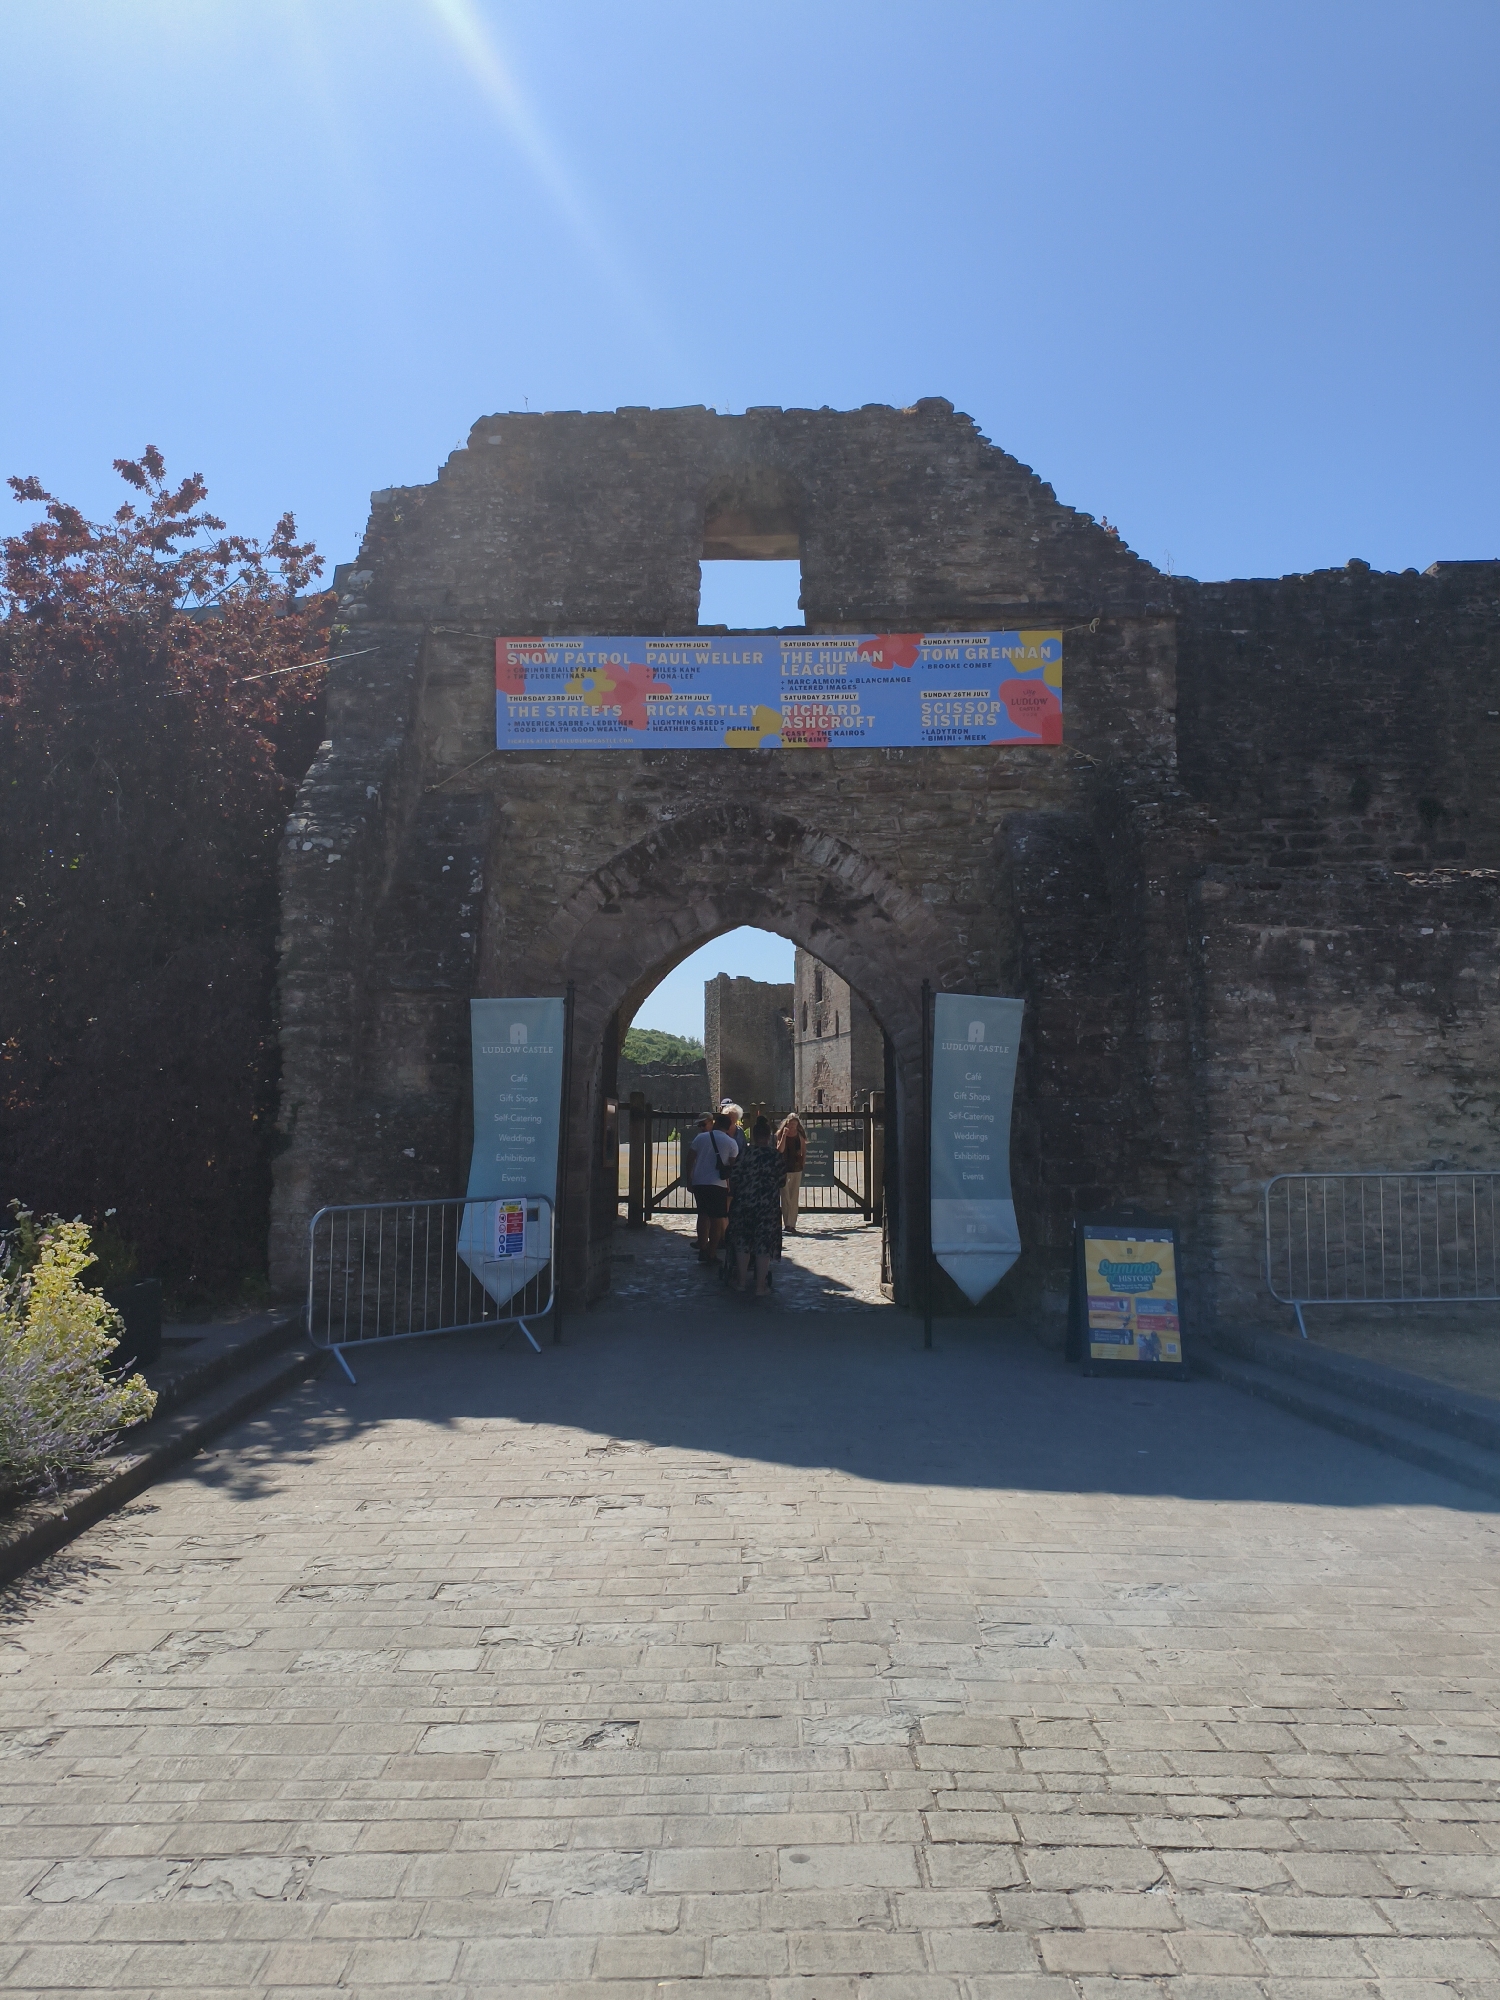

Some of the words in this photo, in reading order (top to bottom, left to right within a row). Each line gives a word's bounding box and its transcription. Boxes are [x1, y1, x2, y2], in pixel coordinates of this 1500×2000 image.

[507, 652, 559, 664] SNOW
[564, 652, 631, 664] PATROL
[646, 652, 690, 664] PAUL
[696, 652, 763, 664] WELLER
[781, 651, 813, 664] THE
[820, 650, 883, 663] HUMAN
[921, 648, 959, 661] TOM
[965, 646, 1051, 660] GRENNAN
[781, 664, 847, 676] LEAGUE
[508, 706, 540, 717] THE
[546, 705, 623, 717] STREETS
[646, 705, 688, 716] RICK
[694, 704, 759, 716] ASTLEY
[781, 705, 861, 716] RICHARD
[921, 702, 1001, 714] SCISSOR
[781, 716, 876, 728] ASHCROFT
[921, 714, 997, 727] SISTERS
[942, 1043, 976, 1051] LUDLOW
[979, 1045, 1009, 1054] CASTLE
[511, 1074, 528, 1082] Café
[965, 1072, 982, 1080] Café
[500, 1094, 513, 1102] Gift
[516, 1094, 538, 1104] Shops
[954, 1092, 967, 1100] Gift
[968, 1092, 990, 1102] Shops
[494, 1114, 542, 1124] Self-Catering
[948, 1112, 994, 1122] Self-Catering
[499, 1134, 535, 1144] Weddings
[954, 1132, 988, 1142] Weddings
[496, 1154, 536, 1162] Exhibitions
[954, 1152, 990, 1160] Exhibitions
[502, 1174, 526, 1182] Events
[962, 1172, 984, 1180] Events
[1099, 1260, 1160, 1275] Summer
